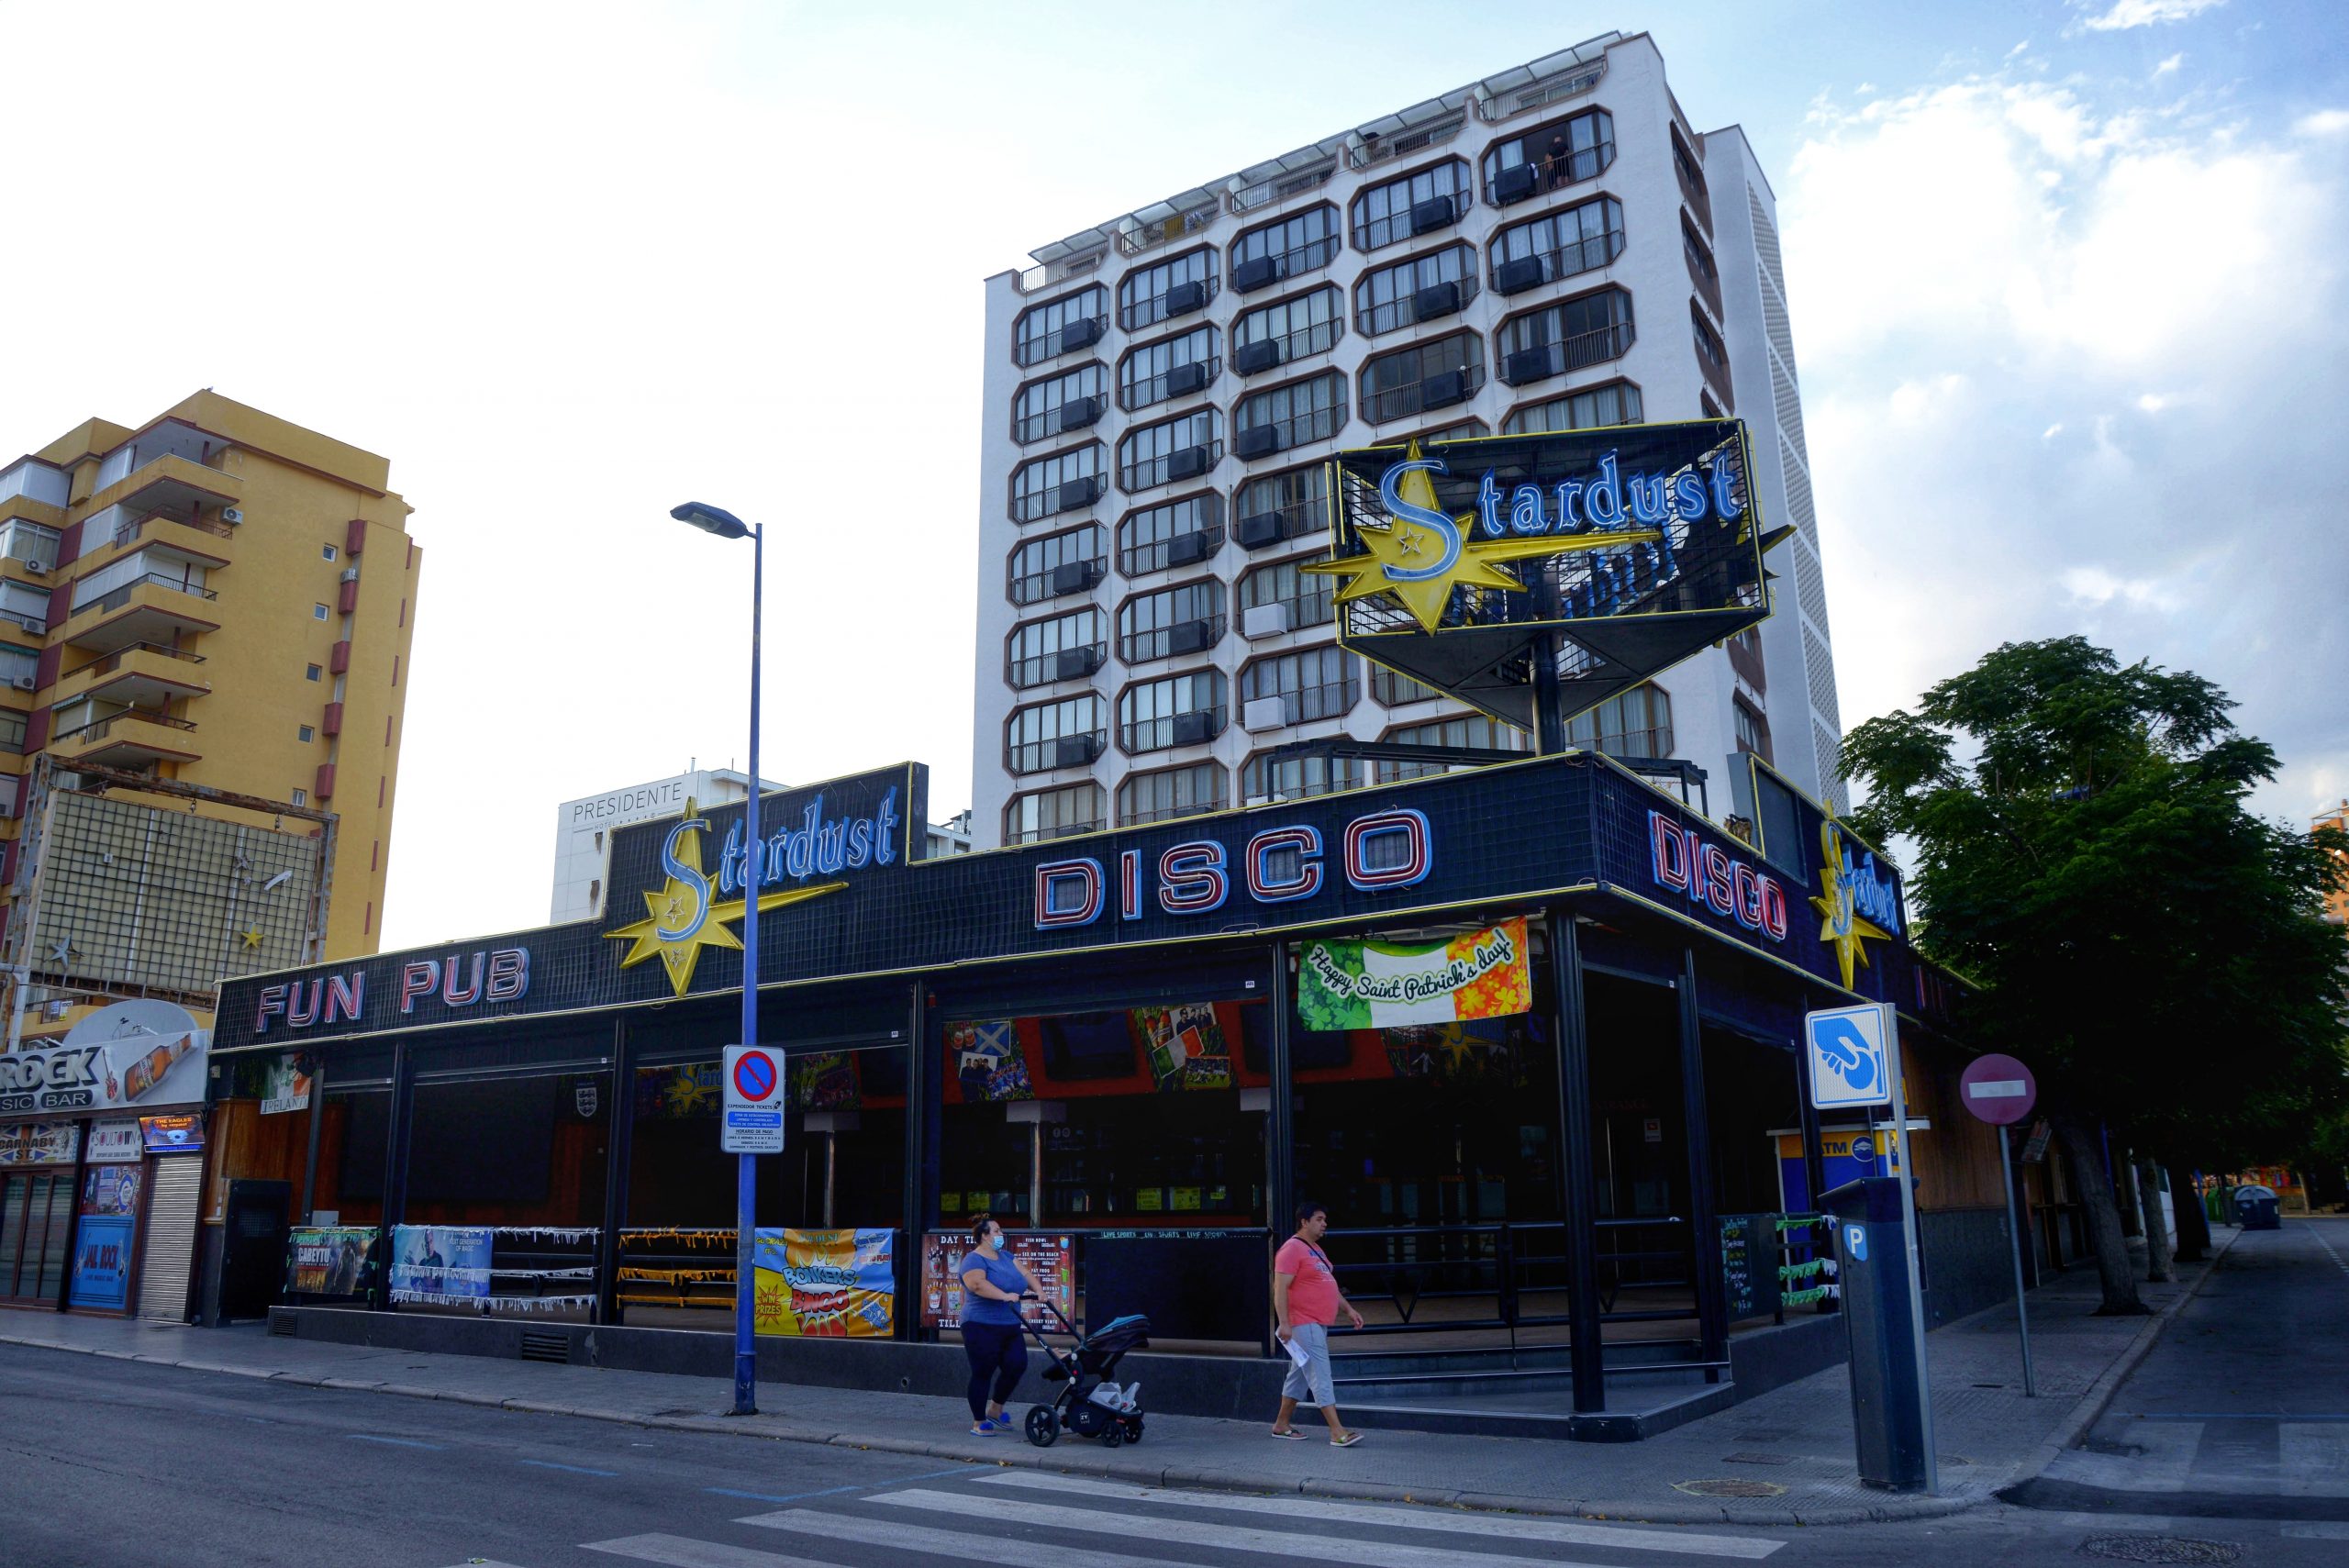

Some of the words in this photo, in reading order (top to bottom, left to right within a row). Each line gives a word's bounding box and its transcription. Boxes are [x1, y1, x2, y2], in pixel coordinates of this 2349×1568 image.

[1380, 448, 1743, 582] Stardust
[573, 782, 683, 823] PRESIDENTE
[661, 784, 900, 943] Stardust
[1034, 808, 1433, 930] DISCO
[1648, 808, 1787, 943] DISCO
[1309, 946, 1353, 995] Happy
[1356, 976, 1401, 998] Saint
[1404, 961, 1477, 1001] Patrick's
[1476, 928, 1513, 973] day!
[256, 971, 365, 1033] FUN
[401, 947, 530, 1014] PUB
[0, 1048, 101, 1093] ROCK
[46, 1093, 87, 1106] BAR
[263, 1098, 308, 1114] IRELAND
[941, 1236, 959, 1244] DAY
[964, 1236, 977, 1244] TI
[1849, 1227, 1864, 1254] P
[99, 1244, 118, 1270] ROCK
[782, 1266, 857, 1287] BONKERS
[755, 1304, 782, 1316] PRIZES
[762, 1294, 776, 1304] WIN
[790, 1288, 851, 1314] BINGO
[938, 1318, 961, 1328] TILL
